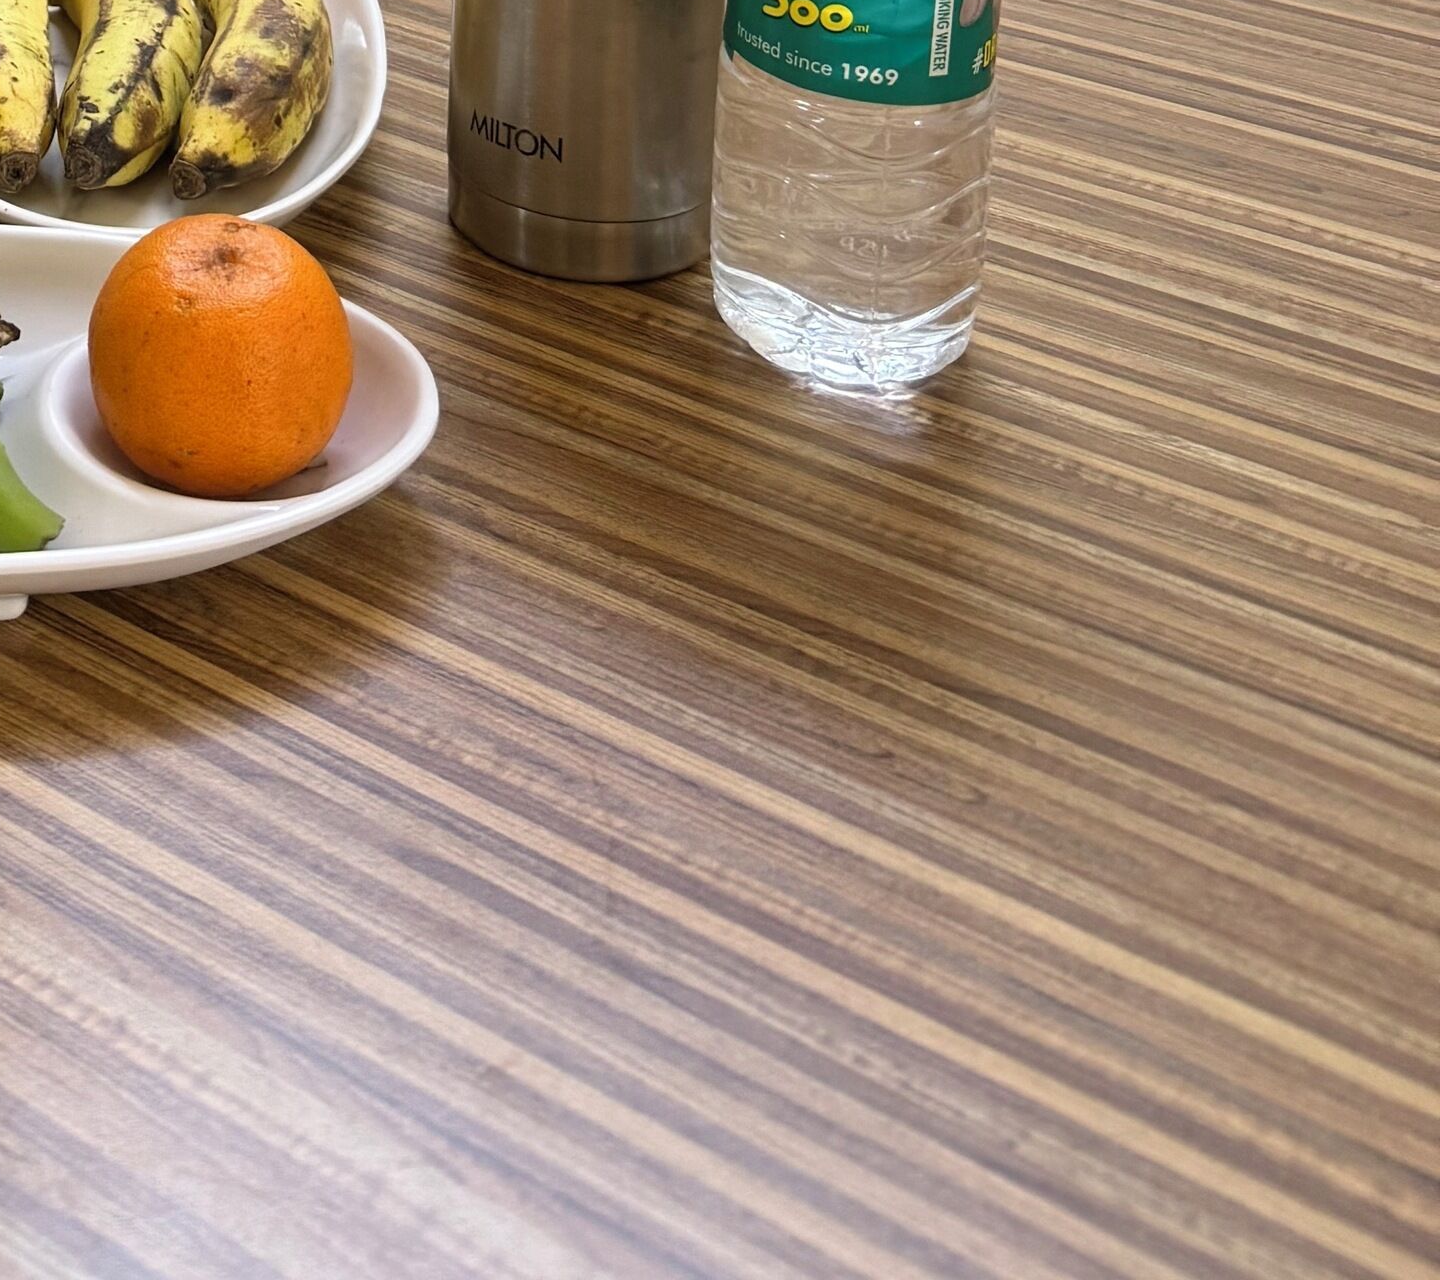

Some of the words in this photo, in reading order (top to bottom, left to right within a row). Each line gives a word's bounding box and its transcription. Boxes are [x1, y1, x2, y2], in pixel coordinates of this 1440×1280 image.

[737, 22, 781, 59] trusted
[785, 50, 833, 76] since
[841, 62, 899, 86] 1969
[932, 33, 949, 72] WATER
[470, 108, 563, 164] MILTON
